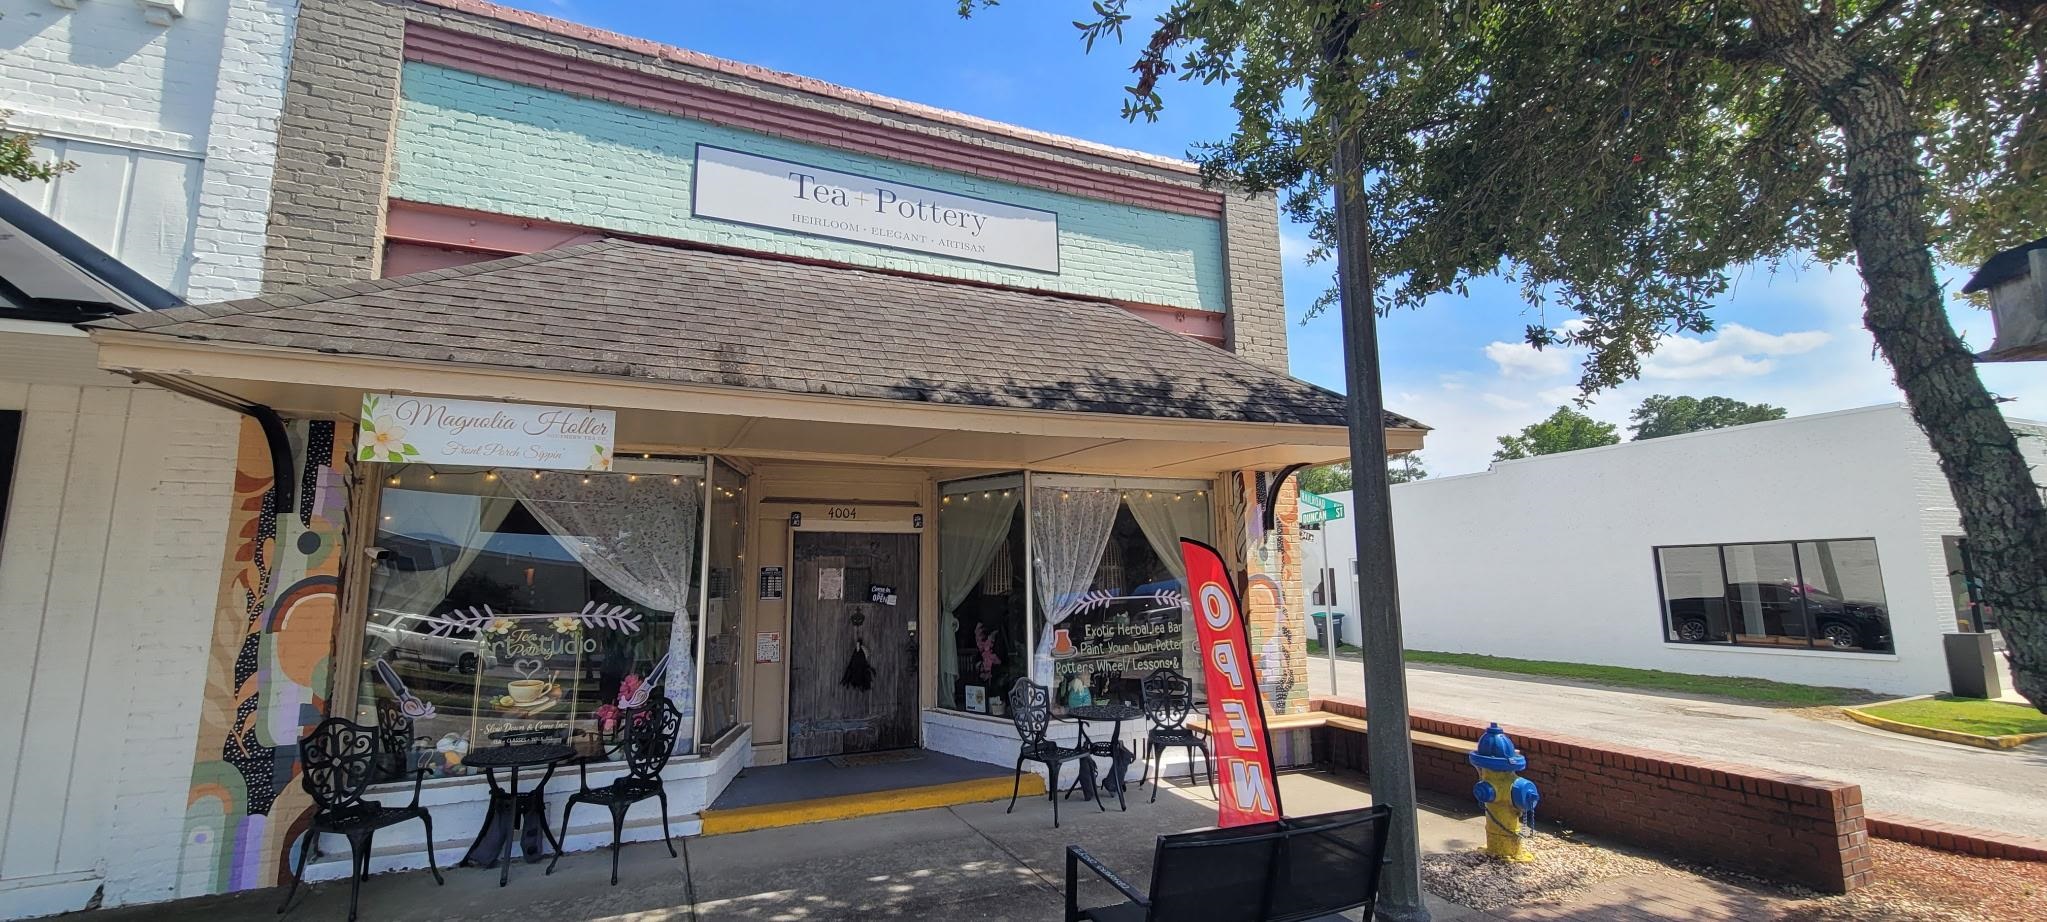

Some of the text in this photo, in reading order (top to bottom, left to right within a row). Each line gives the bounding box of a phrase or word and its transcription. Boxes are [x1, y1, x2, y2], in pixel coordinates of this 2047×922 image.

[789, 172, 849, 207] Tea
[875, 187, 987, 237] Pottery
[791, 213, 986, 253] HEIRLOOM ELEGANT ARTISAN
[396, 400, 608, 435] Magnolia Holler
[442, 441, 480, 456] Front
[482, 443, 520, 456] Porch
[1302, 491, 1325, 509] RAILROAD
[828, 507, 856, 519] 4004
[1303, 507, 1343, 523] DUNCAN ST
[1085, 621, 1183, 637] Exotic Herbal Tea Bar
[1080, 642, 1105, 656] Paint
[1108, 641, 1130, 655] Your
[1133, 640, 1153, 654] Own
[1056, 661, 1094, 674] Potters
[1132, 658, 1169, 670] Lessons
[1172, 656, 1179, 669] &
[503, 722, 525, 733] Down
[535, 721, 554, 732] Come
